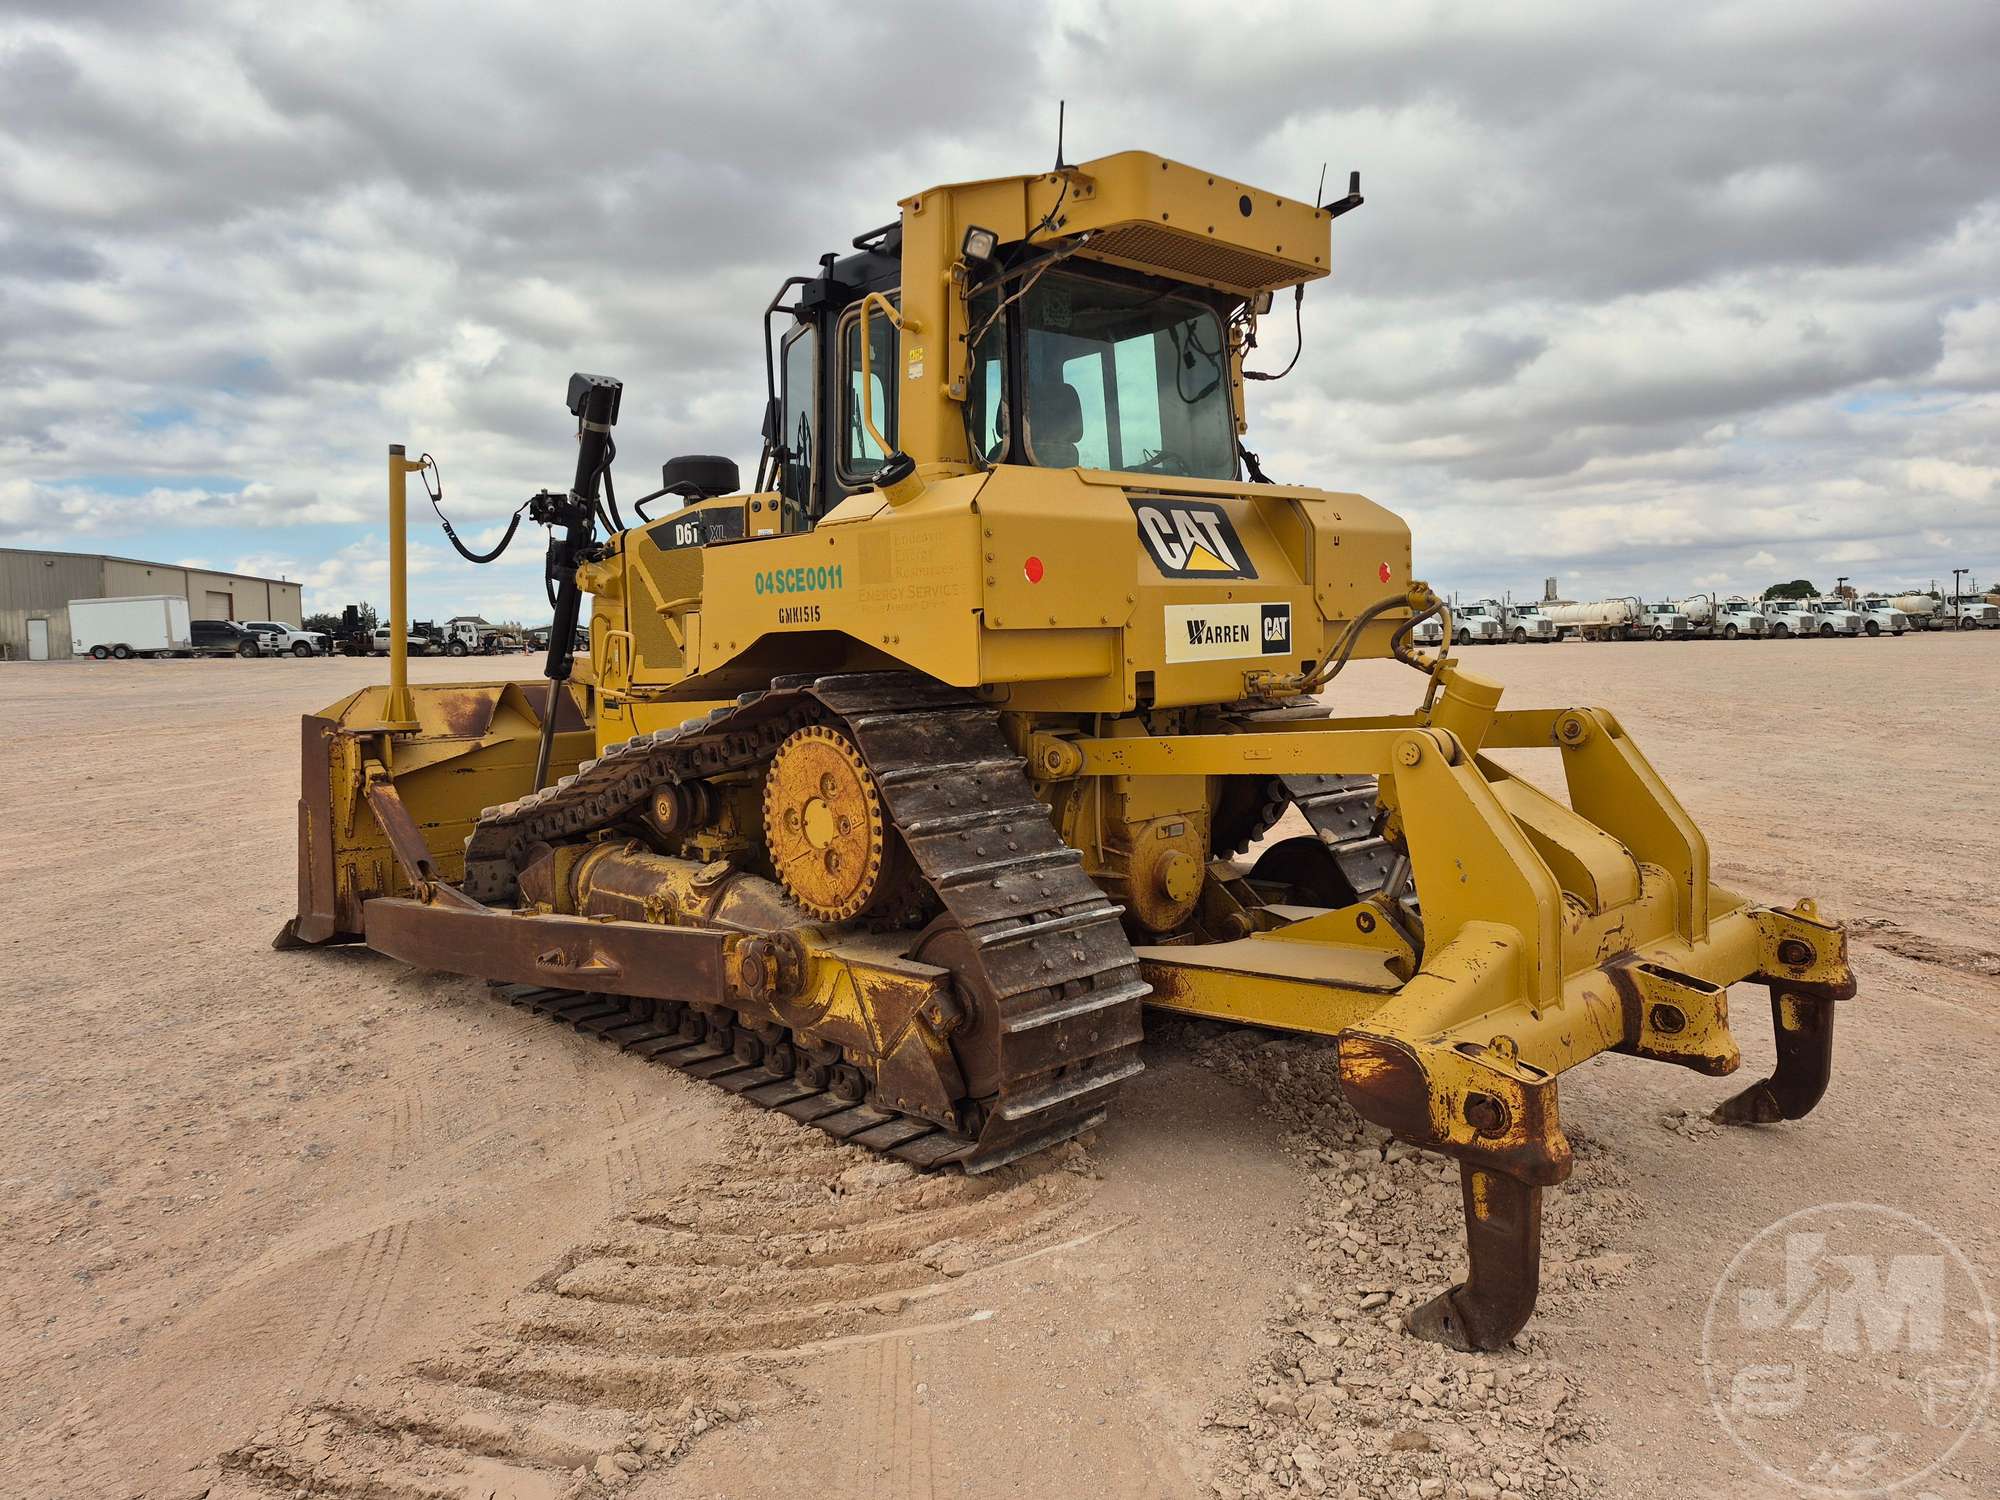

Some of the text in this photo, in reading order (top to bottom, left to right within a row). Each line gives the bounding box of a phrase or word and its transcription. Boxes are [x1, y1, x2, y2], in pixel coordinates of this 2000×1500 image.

[675, 521, 699, 546] D6T
[1138, 507, 1241, 571] CAT
[754, 564, 843, 595] 04SCE0011
[1186, 616, 1289, 645] WARREN CAT
